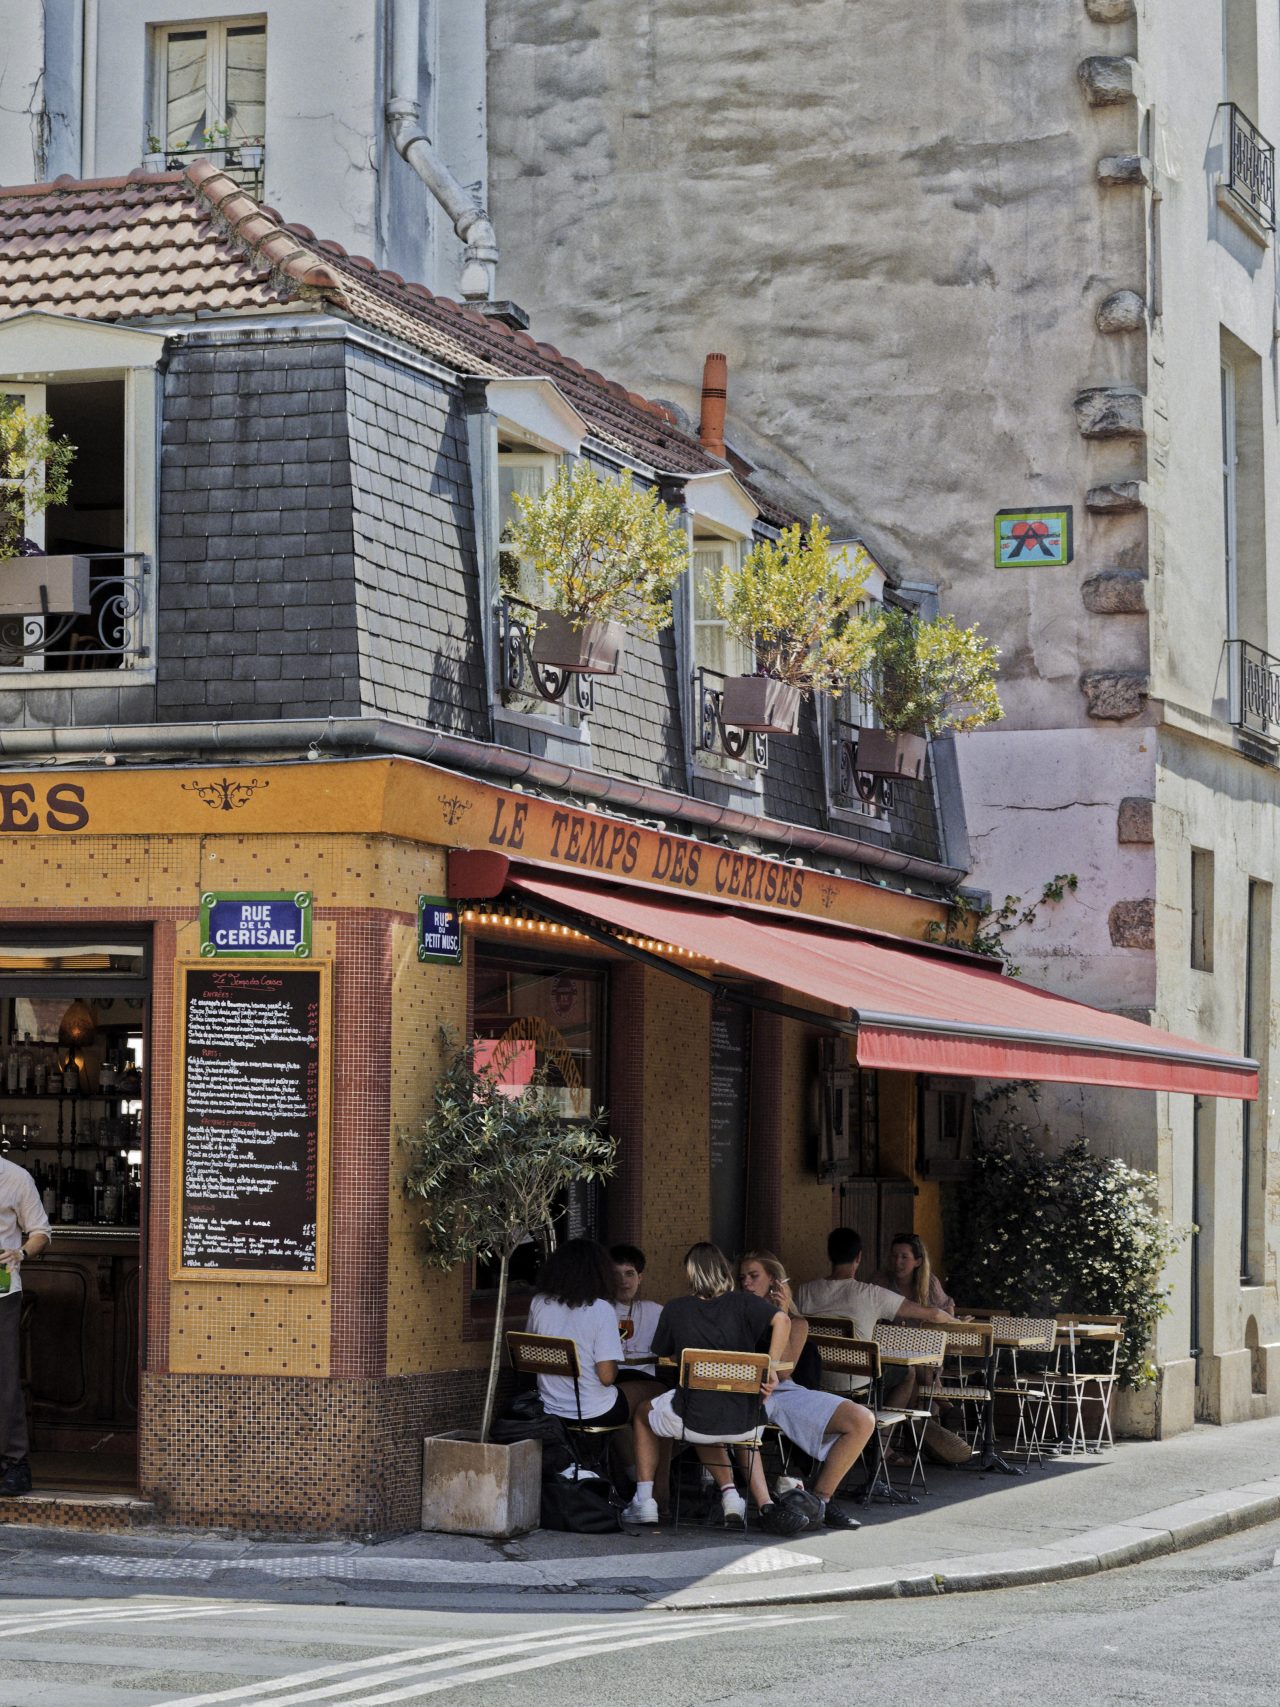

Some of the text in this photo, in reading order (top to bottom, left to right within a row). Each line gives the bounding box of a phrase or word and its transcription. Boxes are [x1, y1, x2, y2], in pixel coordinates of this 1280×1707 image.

[489, 798, 806, 908] LE TEMPS DES CERISES
[241, 905, 272, 921] RUE
[434, 911, 450, 928] RUE
[239, 921, 271, 930] DE LA
[438, 926, 446, 934] DU
[215, 929, 296, 945] CERISAIE
[425, 933, 458, 951] PETIT MUSC
